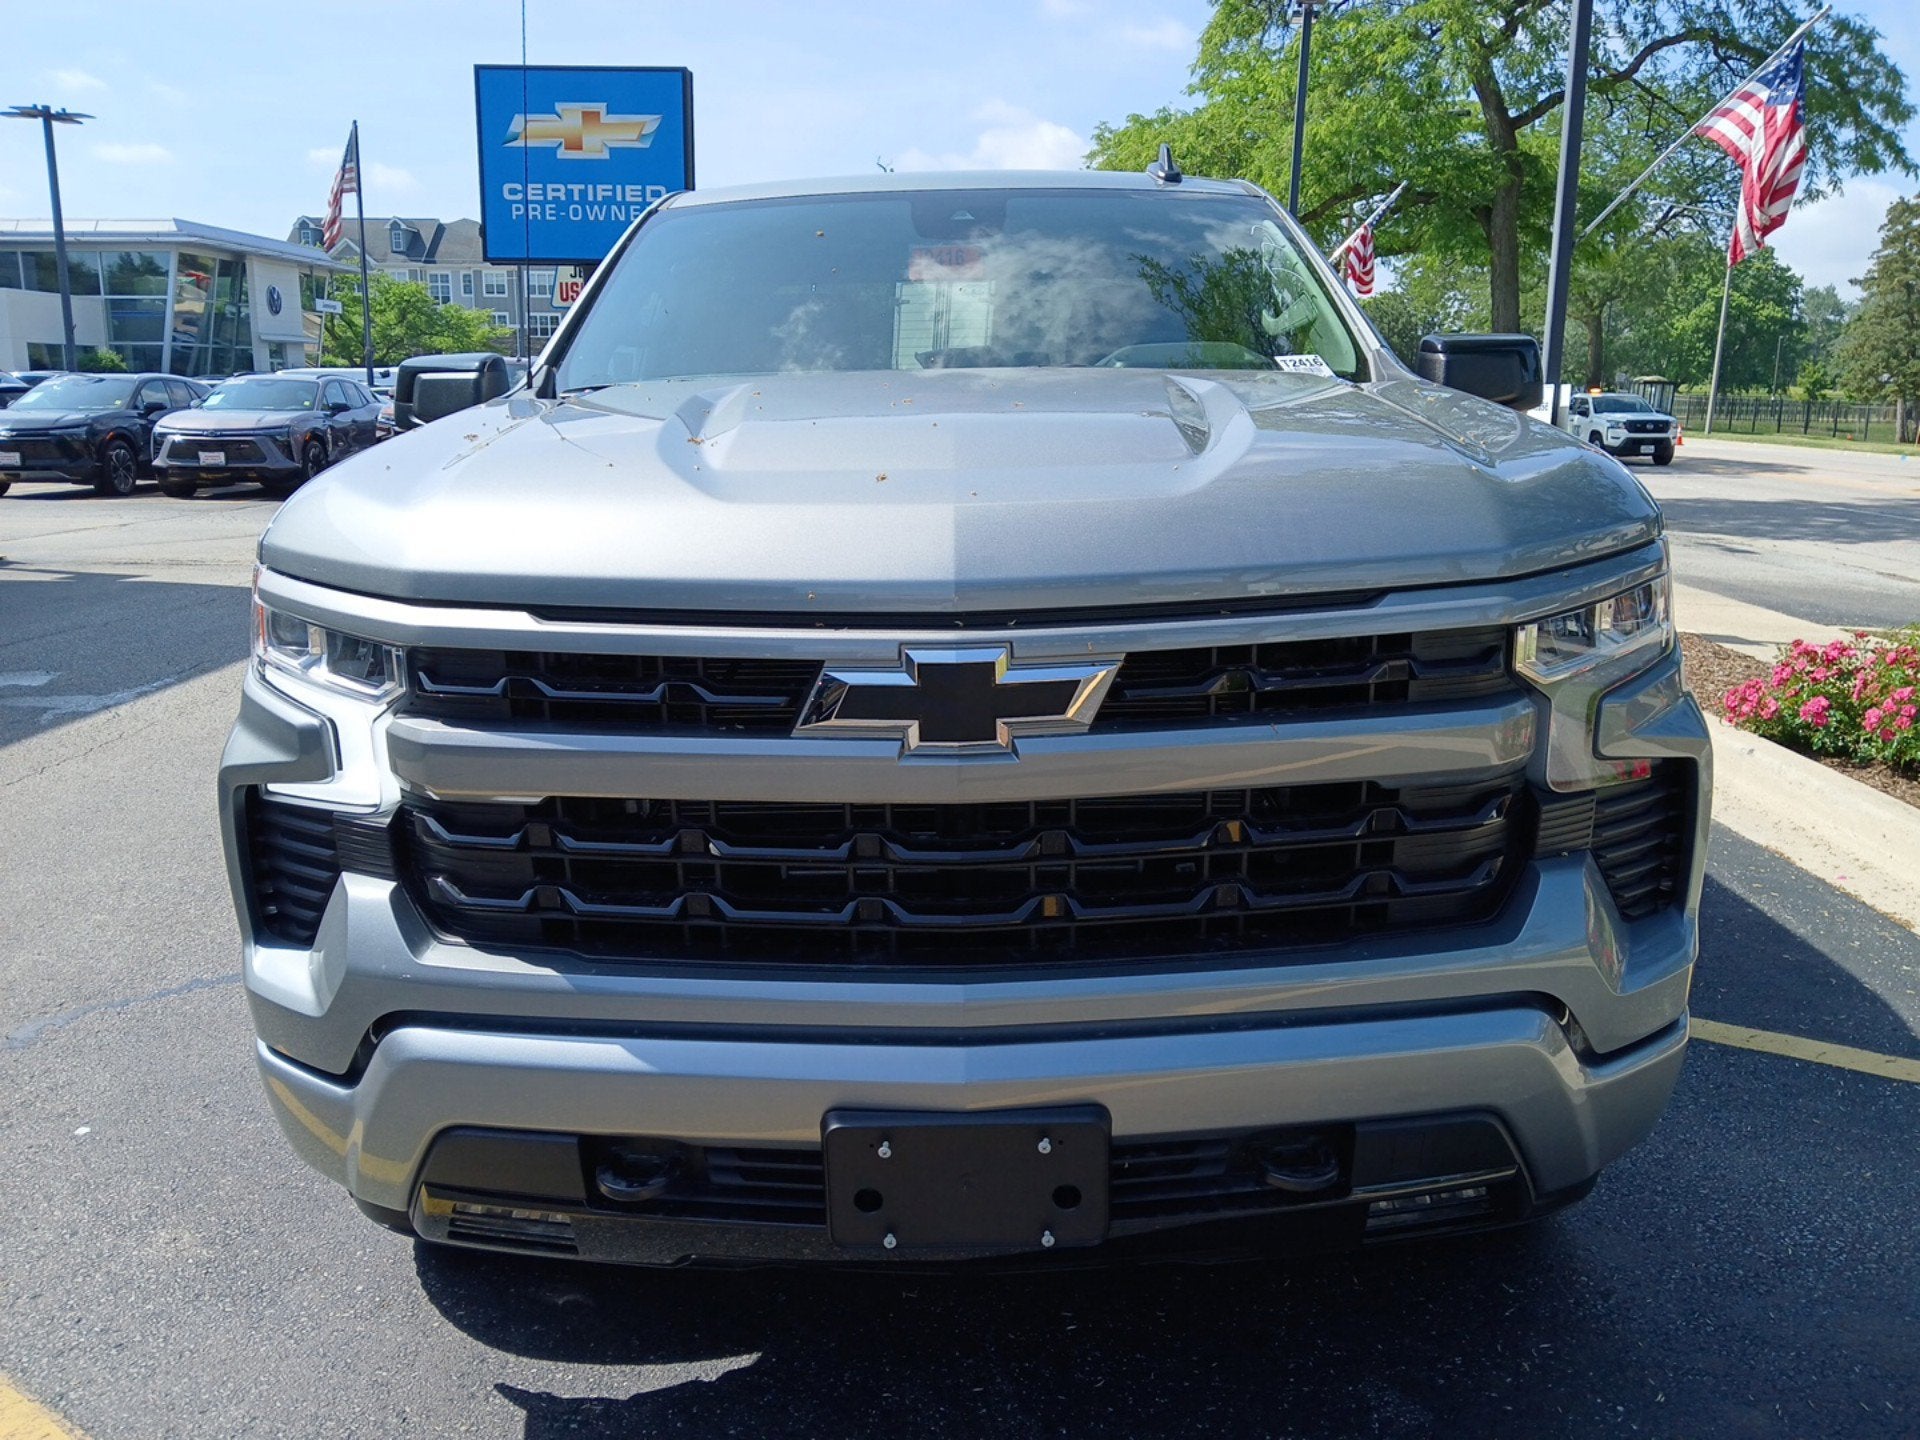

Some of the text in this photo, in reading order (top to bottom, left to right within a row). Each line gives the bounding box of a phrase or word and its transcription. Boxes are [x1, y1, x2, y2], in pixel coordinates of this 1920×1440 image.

[502, 182, 667, 202] CERTIFIED
[512, 203, 651, 221] PRE-OWNE
[559, 281, 584, 302] US
[1279, 355, 1324, 368] T2416
